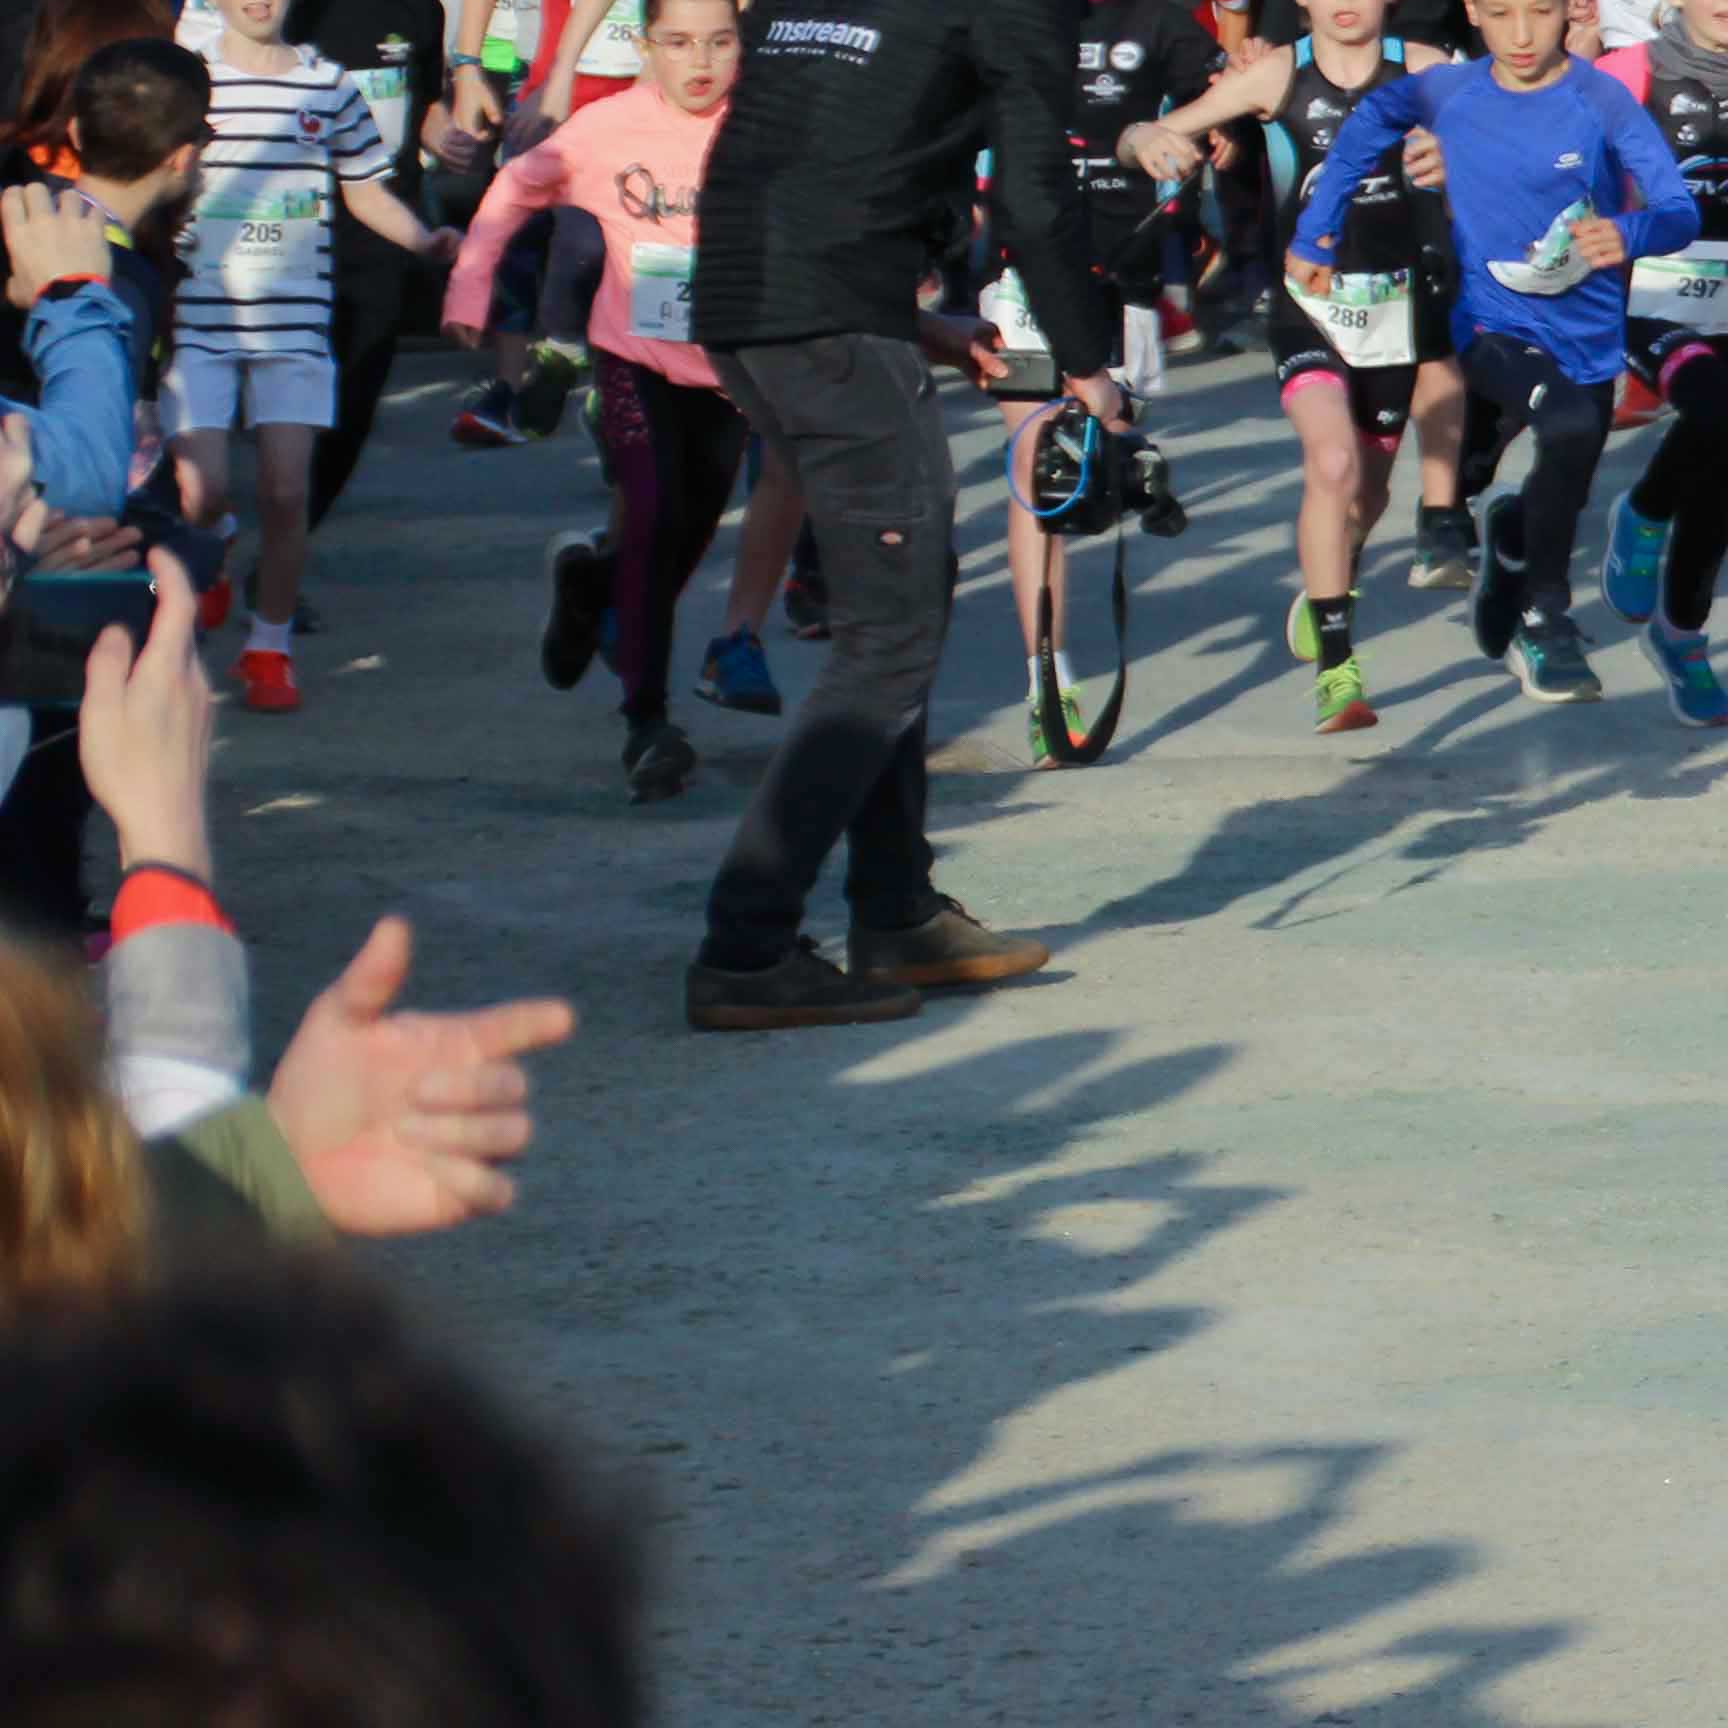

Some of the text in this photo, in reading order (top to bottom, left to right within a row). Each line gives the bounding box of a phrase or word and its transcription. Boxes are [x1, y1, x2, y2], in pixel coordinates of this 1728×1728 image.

[765, 20, 881, 52] mstream
[240, 222, 283, 244] 205
[1677, 276, 1721, 299] 297
[1327, 304, 1368, 329] 288
